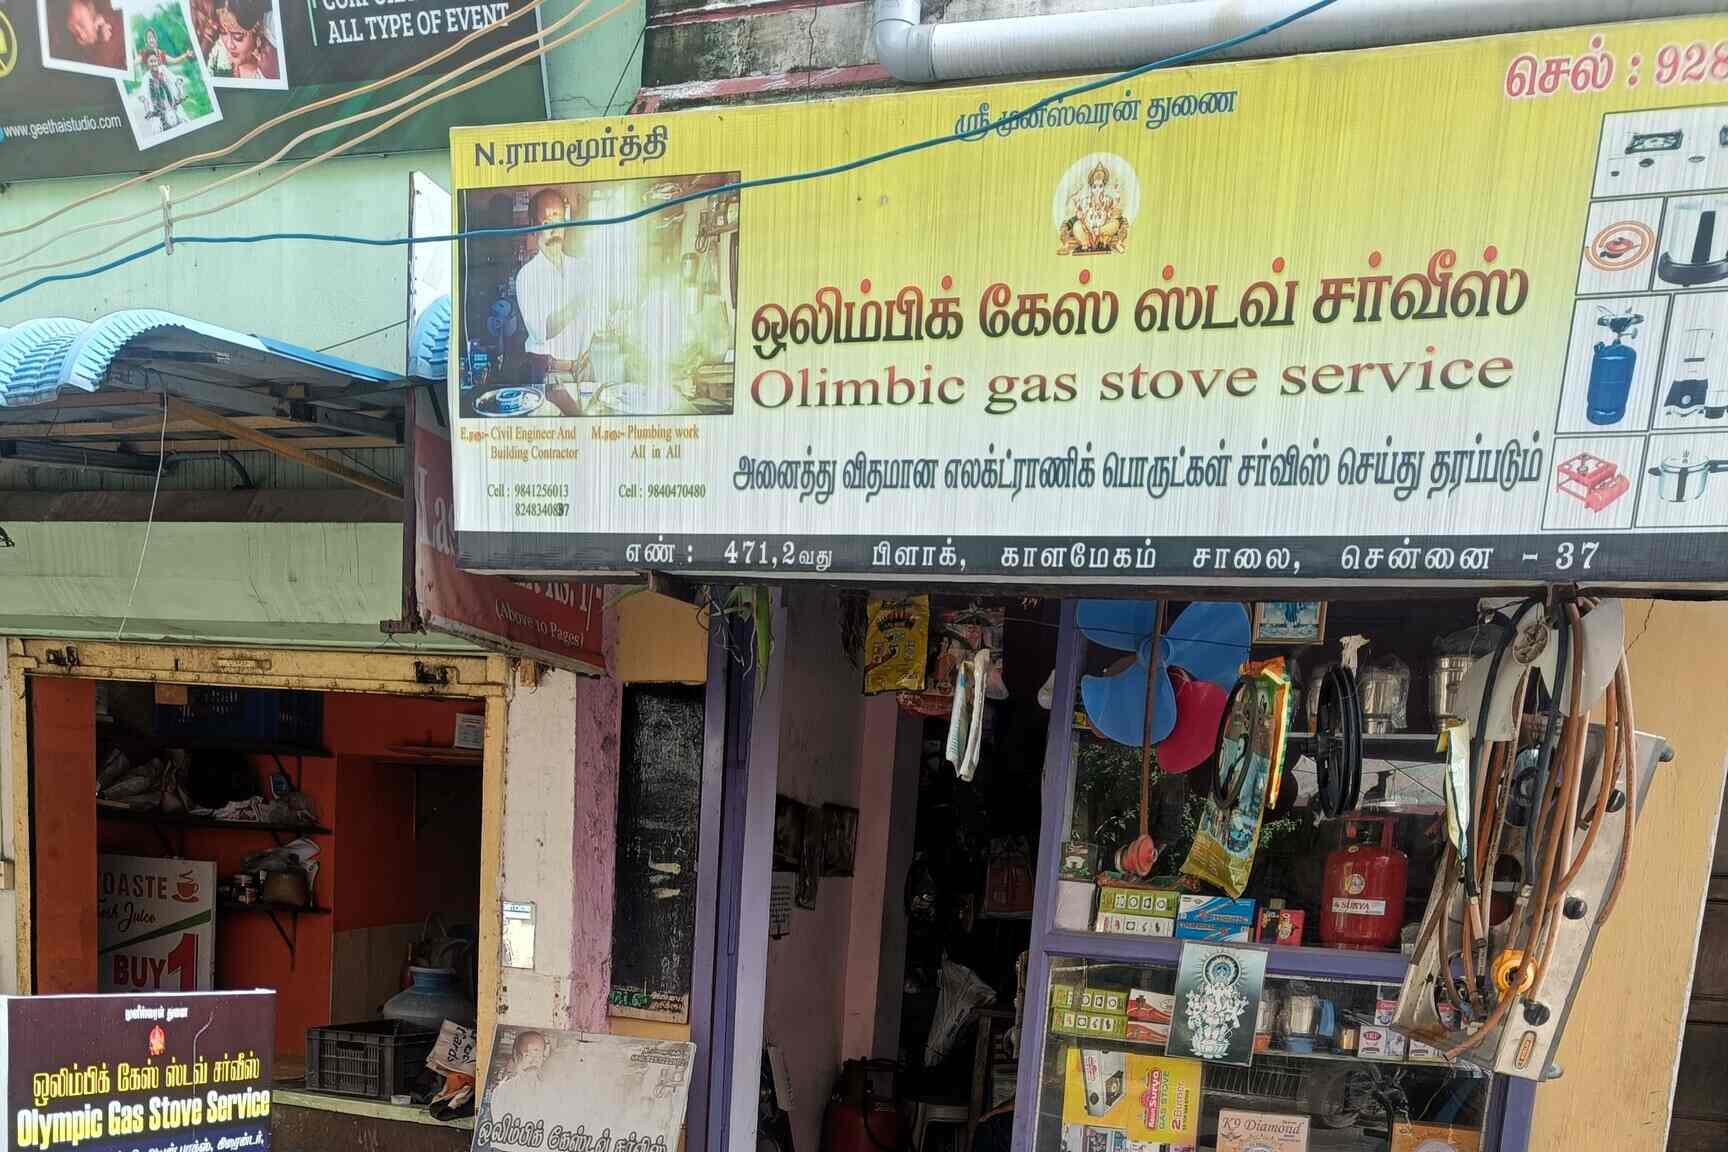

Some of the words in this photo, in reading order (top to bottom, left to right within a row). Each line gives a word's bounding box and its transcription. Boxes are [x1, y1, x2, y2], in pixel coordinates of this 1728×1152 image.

[328, 20, 364, 45] ALL
[365, 12, 414, 40] TYPE
[417, 9, 441, 36] OF
[446, 2, 510, 33] EVENT
[1505, 34, 1616, 98] செல்
[4, 115, 122, 139] www.geethaistudio.com
[1146, 89, 1239, 129] துணை
[474, 124, 669, 174] N.ராமமூர்த்தி
[750, 275, 964, 359] ஒலிம்பிக்
[978, 267, 1119, 337] கேஸ்
[1135, 257, 1299, 333] ஸ்டவ்
[1312, 245, 1529, 324] சர்வீஸ்
[750, 364, 966, 409] Olimbic
[986, 370, 1077, 414] gas
[1100, 355, 1258, 402] stove
[1280, 346, 1514, 396] service
[490, 426, 513, 441] Civil
[515, 426, 555, 444] Engineer
[558, 426, 576, 441] And
[627, 424, 673, 442] Plumbing
[674, 424, 699, 440] work
[490, 446, 529, 461] Building
[531, 446, 578, 460] Contractor
[630, 445, 646, 459] All
[651, 446, 661, 459] in
[666, 444, 681, 459] All
[733, 445, 838, 504] அனைத்து
[843, 450, 939, 502] விதமான
[944, 441, 1095, 502] எலக்ட்ராணிக்
[1102, 438, 1232, 499] பொருட்கள்
[1337, 435, 1425, 501] செய்து
[1426, 430, 1544, 499] தரப்படும்
[487, 484, 504, 497] Cell
[514, 484, 569, 498] 9841256013
[618, 484, 637, 498] Cell
[647, 484, 706, 498] 9840470480
[626, 536, 676, 564] எண்
[872, 538, 966, 570] பிளாக்,
[1001, 537, 1156, 567] காளமேகம்
[1192, 539, 1301, 574] சாலை,
[1341, 537, 1494, 569] சென்னை
[1555, 541, 1600, 569] 37
[113, 954, 167, 989] BUY
[33, 1062, 111, 1107] ஒலிம்பிக்
[118, 1059, 159, 1092] கேஸ்
[165, 1056, 208, 1088] ஸ்டவ்
[213, 1051, 260, 1083] சர்வீஸ்
[17, 1103, 103, 1150] Olympic
[108, 1100, 144, 1136] Gas
[149, 1095, 202, 1131] Stove
[206, 1086, 271, 1124] Service
[478, 1113, 544, 1148] ஒலிம்பிக்
[1223, 1117, 1241, 1129] K9
[1244, 1118, 1304, 1135] Diamond
